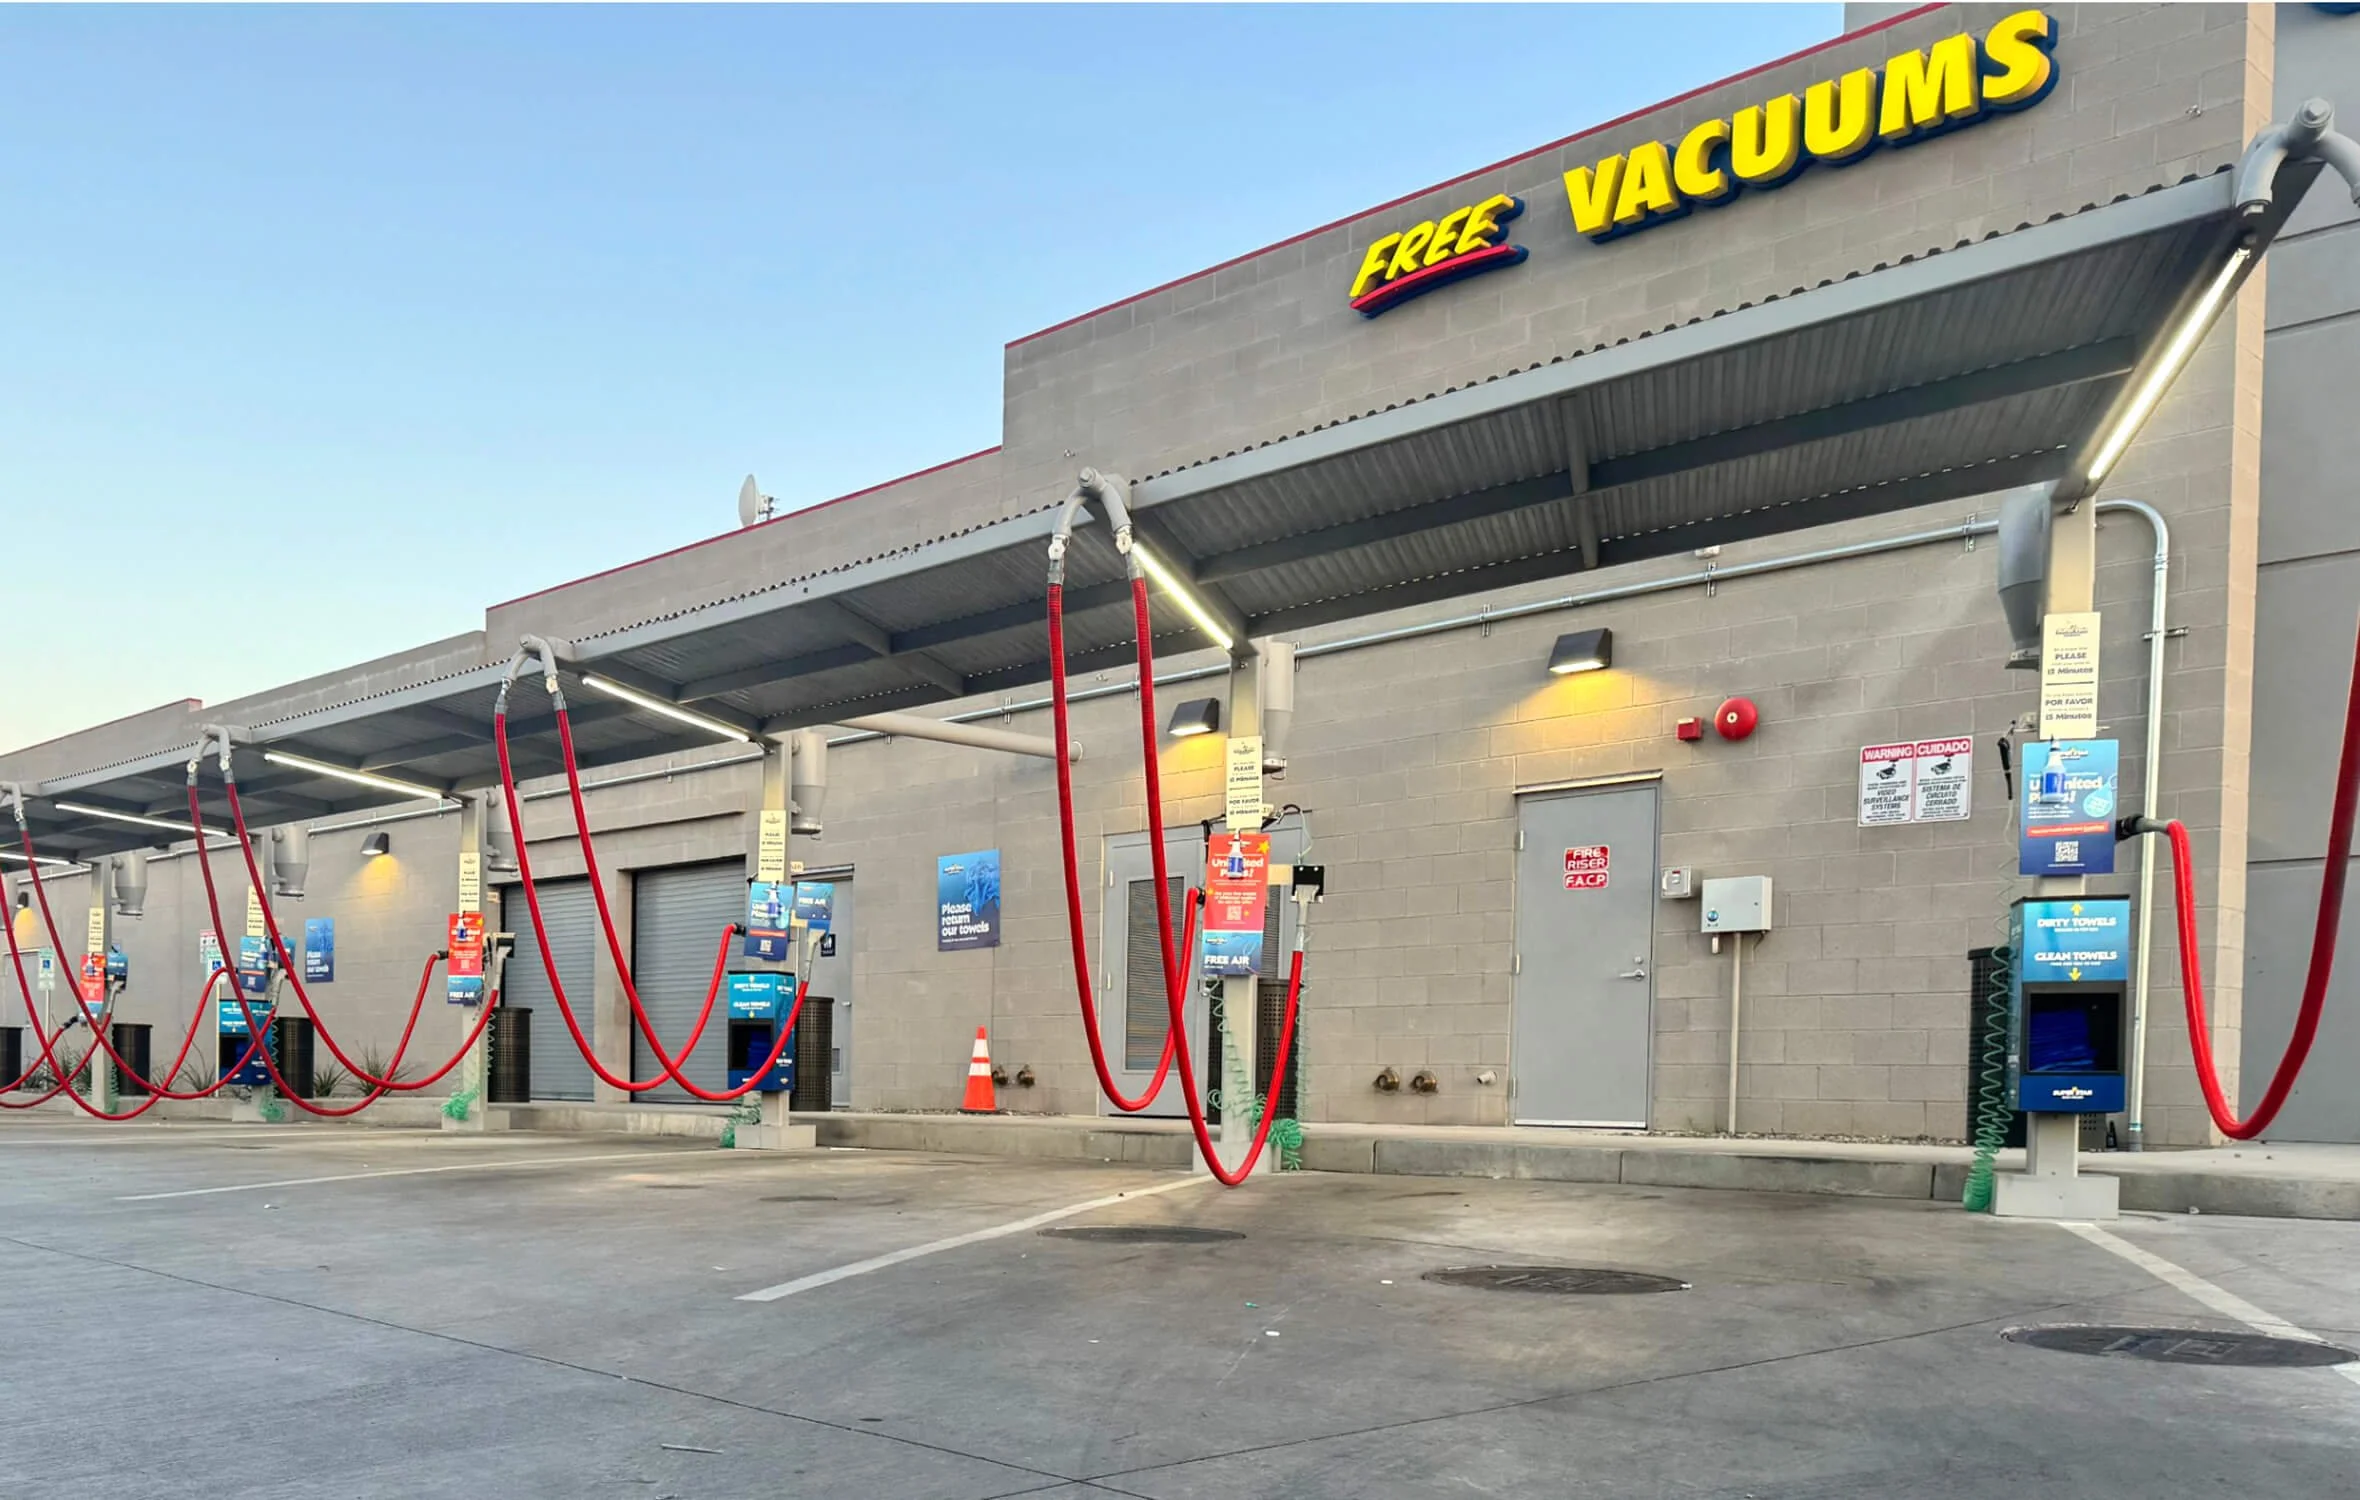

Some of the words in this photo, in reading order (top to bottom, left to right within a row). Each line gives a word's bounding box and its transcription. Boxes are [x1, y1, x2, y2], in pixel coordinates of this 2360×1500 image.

[1350, 193, 1515, 297] FREE
[1563, 9, 2055, 238] VACUUMS
[2055, 652, 2087, 660] PLEASE
[1864, 746, 1912, 761] WARNING
[1917, 741, 1969, 755] CUIDADO
[1921, 784, 1950, 792] SISTEMA
[1863, 795, 1909, 804] SURVEILLANCE
[1926, 791, 1957, 799] CIRCUITO
[1573, 848, 1601, 859] FIRE
[1567, 858, 1606, 870] RISER
[1566, 874, 1605, 887] FACP
[942, 902, 972, 915] Please
[942, 914, 970, 926] return
[2037, 918, 2070, 928] DIRTY
[2072, 917, 2117, 926] TOWELS
[942, 926, 958, 936] our
[960, 921, 989, 935] towels
[1204, 955, 1229, 964] FREE
[1231, 955, 1250, 965] AIR
[2034, 952, 2071, 961] CLEAN
[2073, 951, 2118, 960] TOWELS
